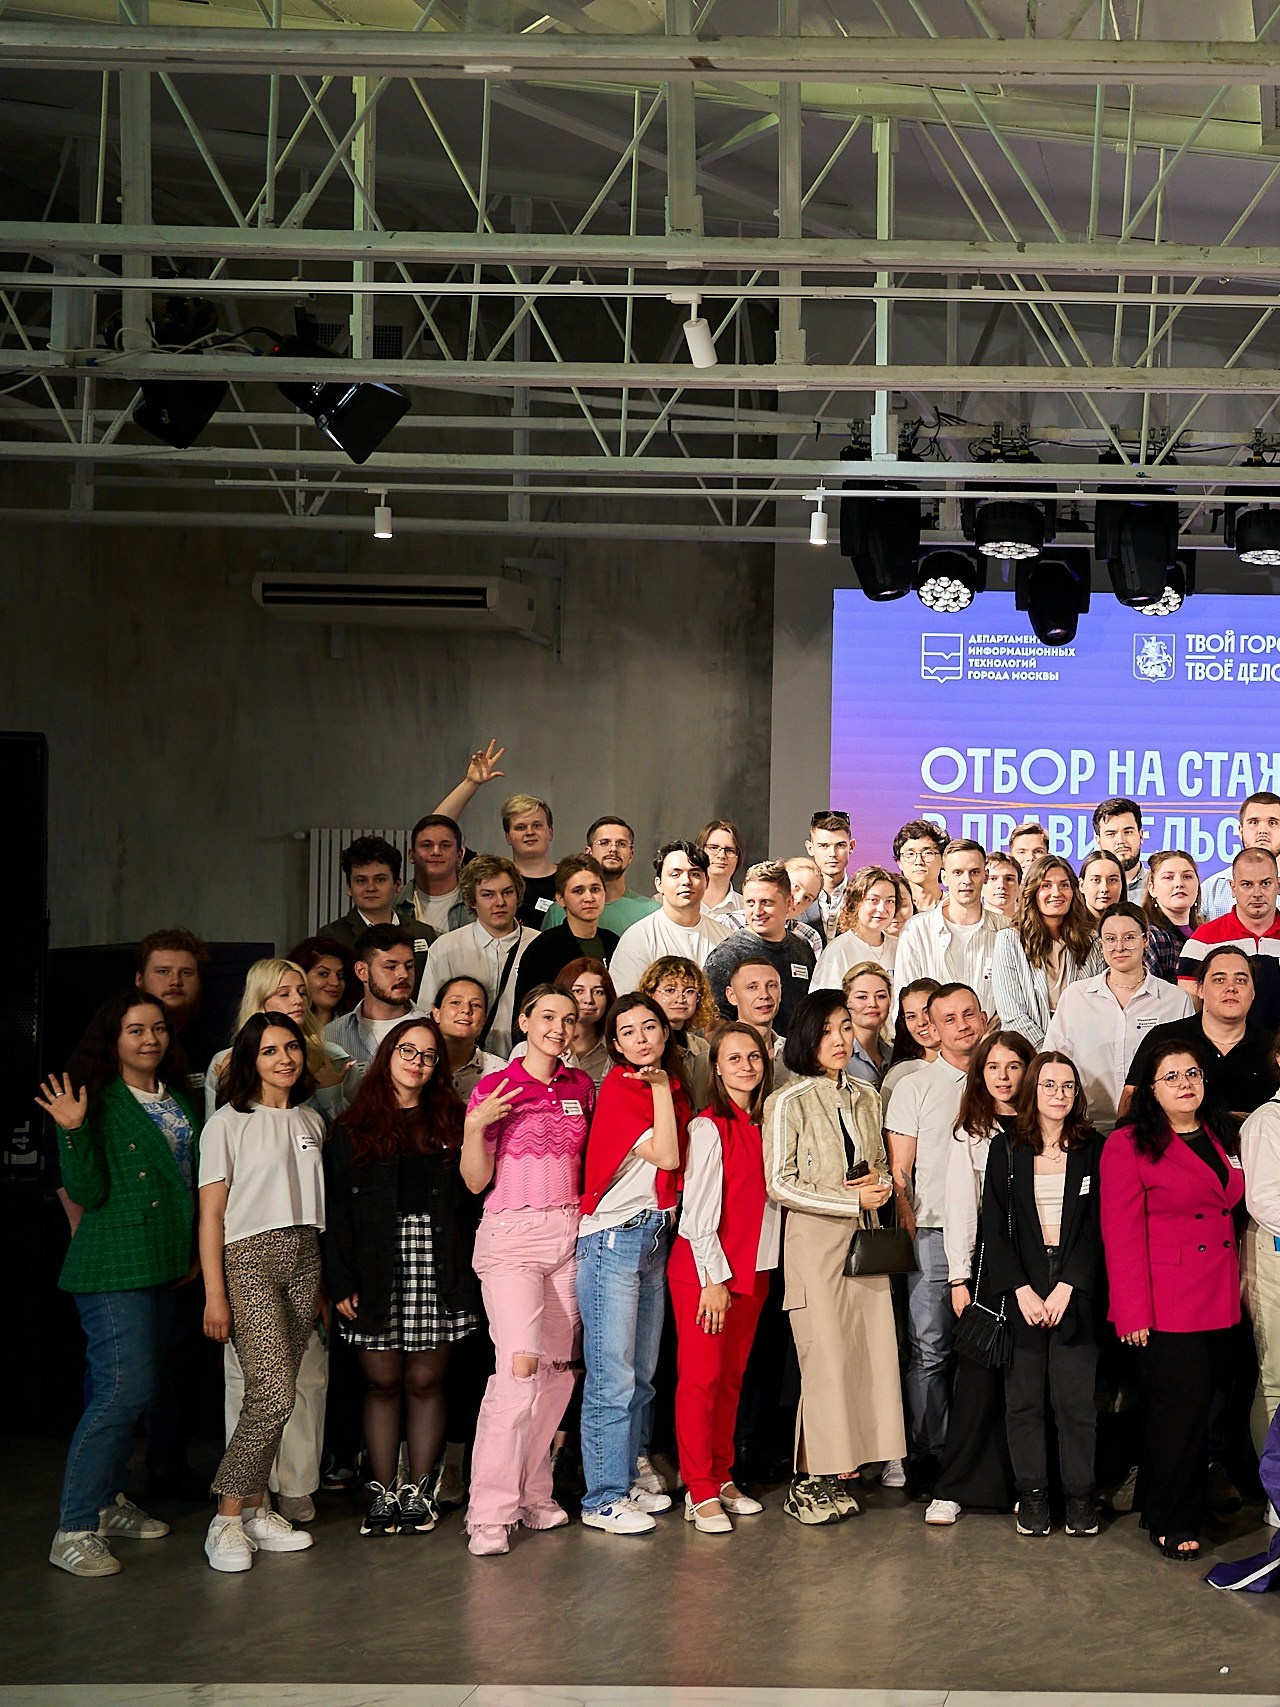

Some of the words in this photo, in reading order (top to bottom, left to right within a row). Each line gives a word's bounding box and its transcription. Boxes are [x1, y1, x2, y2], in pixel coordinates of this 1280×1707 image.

[1185, 629, 1235, 653] ТВОЙ
[968, 647, 1076, 657] ИНФОРМАЦИОННЫХ
[968, 657, 1037, 668] ТЕХНОЛОГИЙ
[1185, 658, 1234, 681] ТВОЁ
[967, 671, 1009, 681] ГОРОДА
[1012, 671, 1059, 681] МОСКВЫ
[921, 747, 1095, 795] ОТБОР
[1109, 750, 1166, 796] НА
